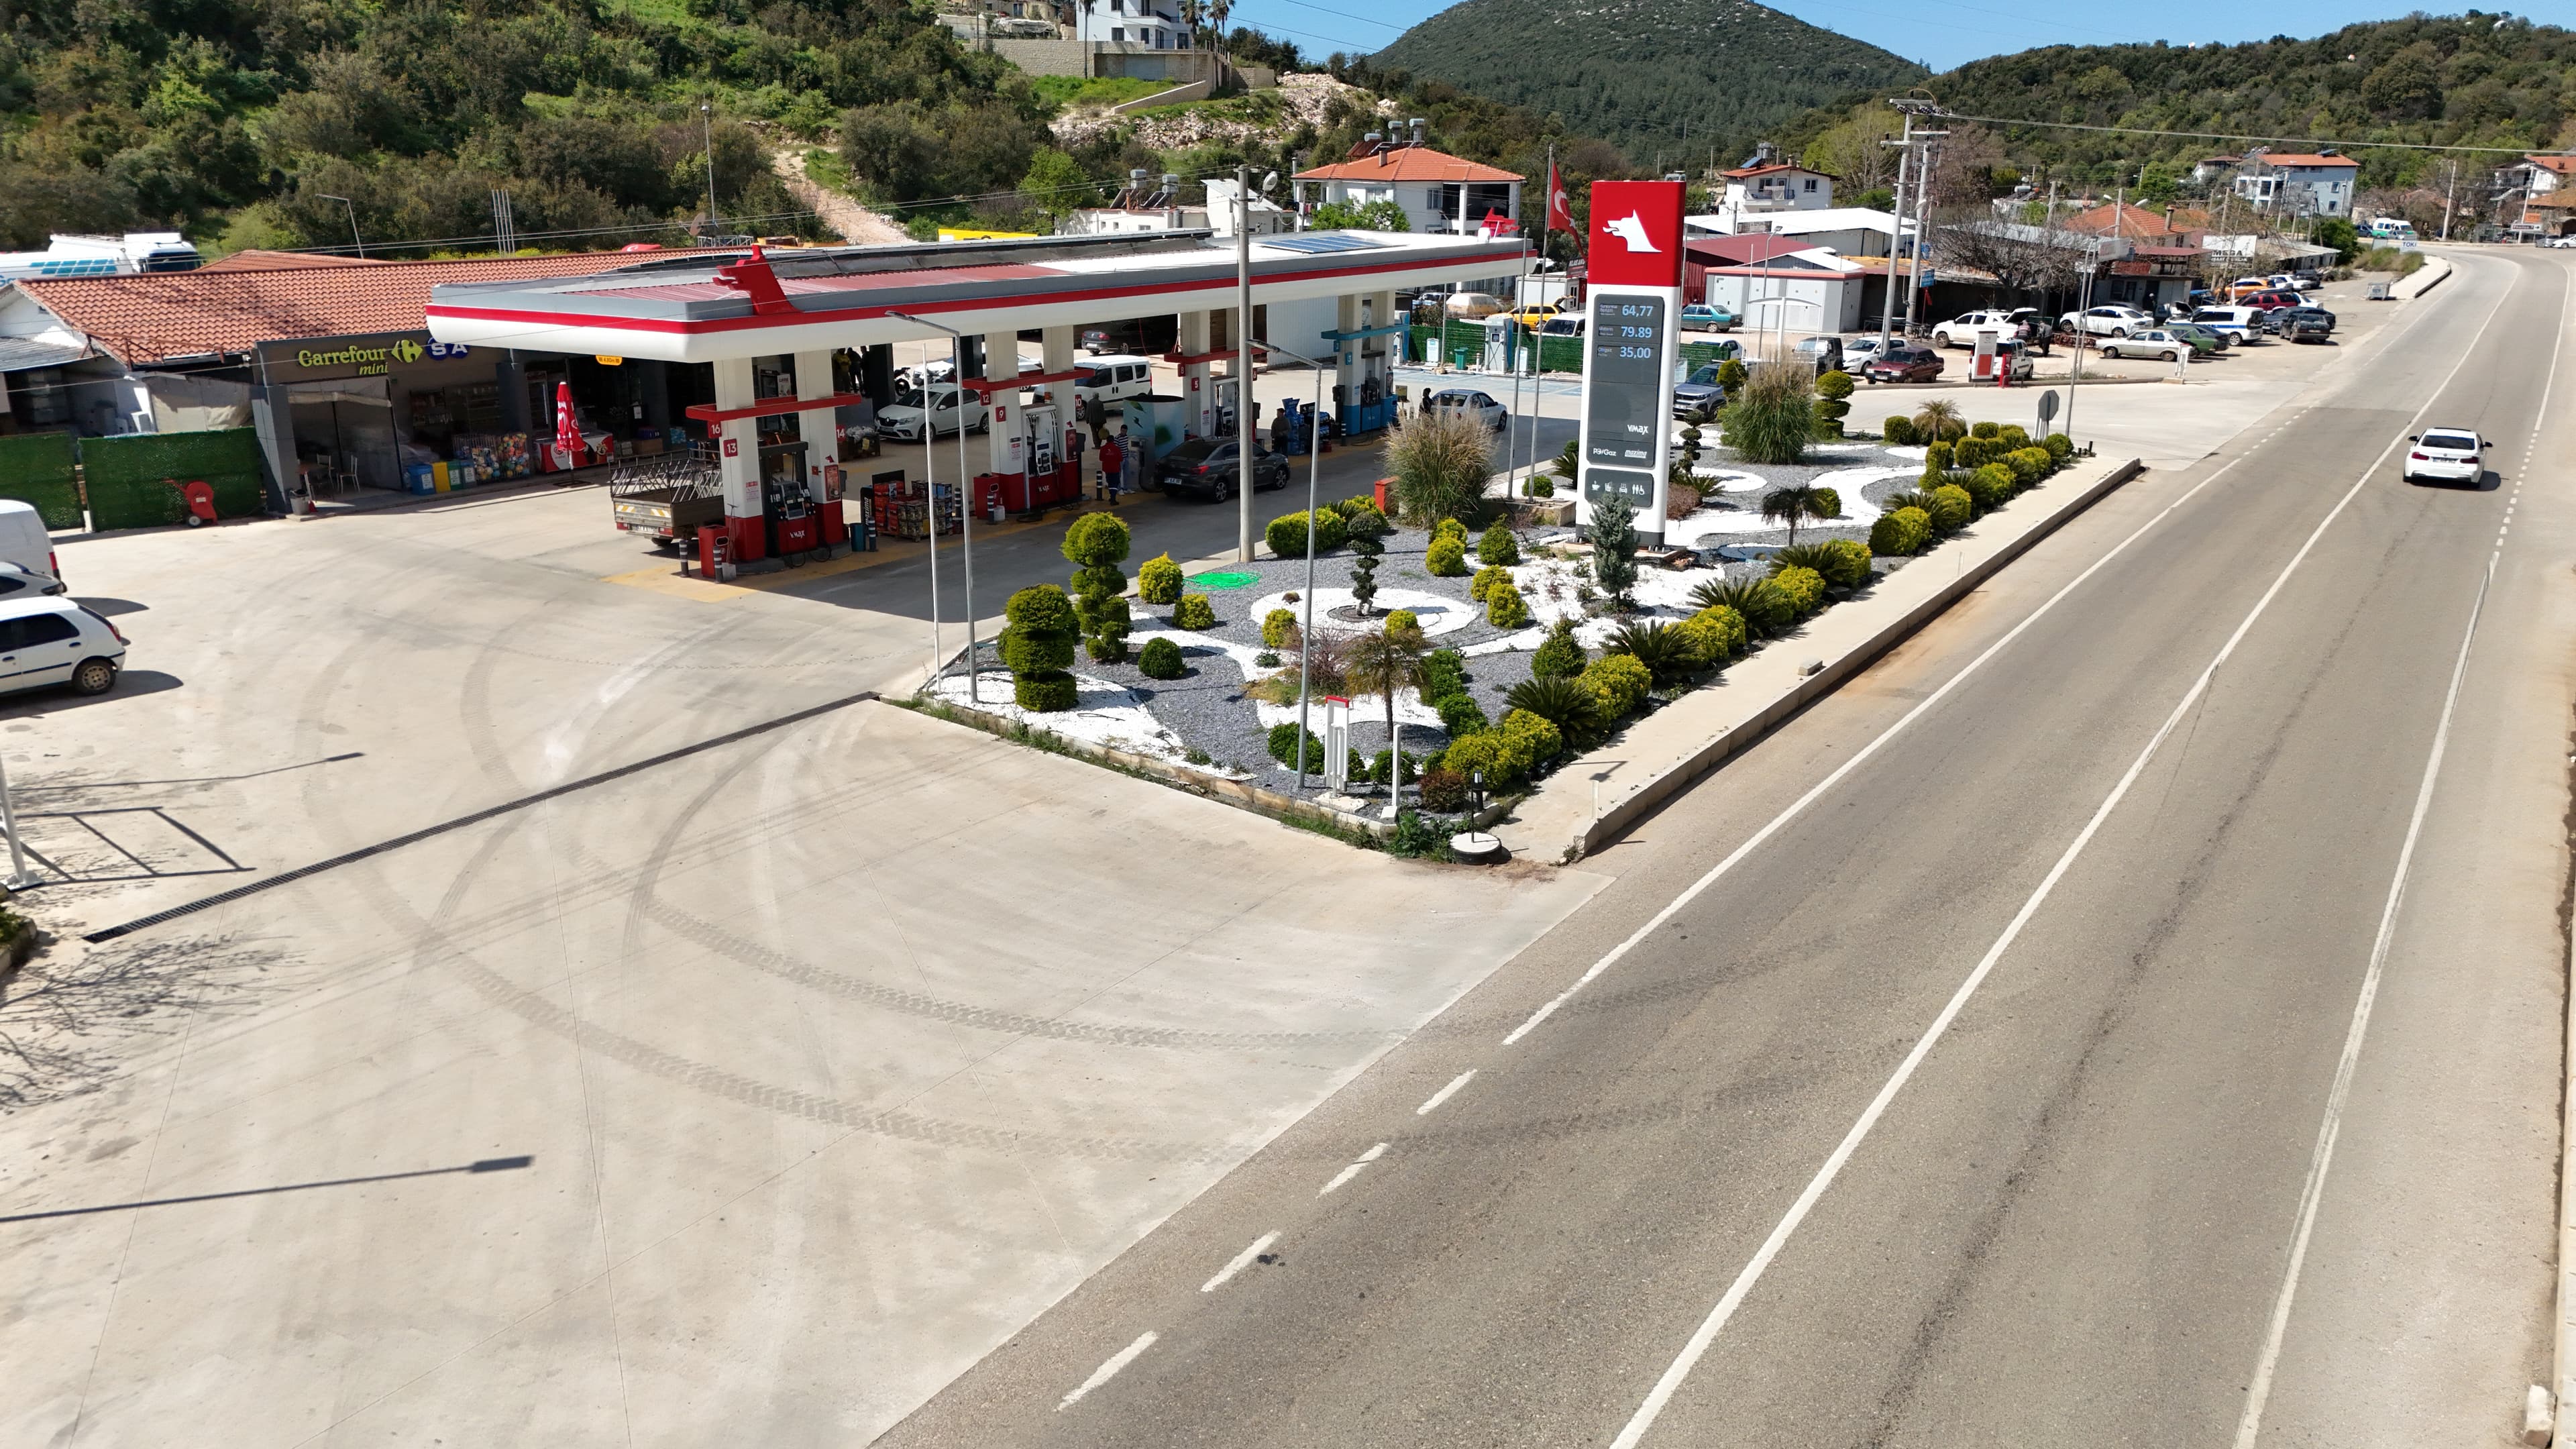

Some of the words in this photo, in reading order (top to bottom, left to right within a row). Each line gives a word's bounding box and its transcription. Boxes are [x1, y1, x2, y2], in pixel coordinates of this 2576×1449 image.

[1622, 305, 1653, 317] 64,77
[1621, 326, 1652, 338] 79.89
[299, 345, 386, 367] Carrefour
[1619, 346, 1651, 359] 35,00
[359, 362, 389, 375] mini
[1195, 380, 1199, 388] 5
[983, 394, 989, 402] 12
[1075, 398, 1081, 407] 10
[999, 410, 1004, 419] 9
[711, 424, 720, 434] 16
[837, 429, 845, 437] 14
[727, 443, 737, 453] 13
